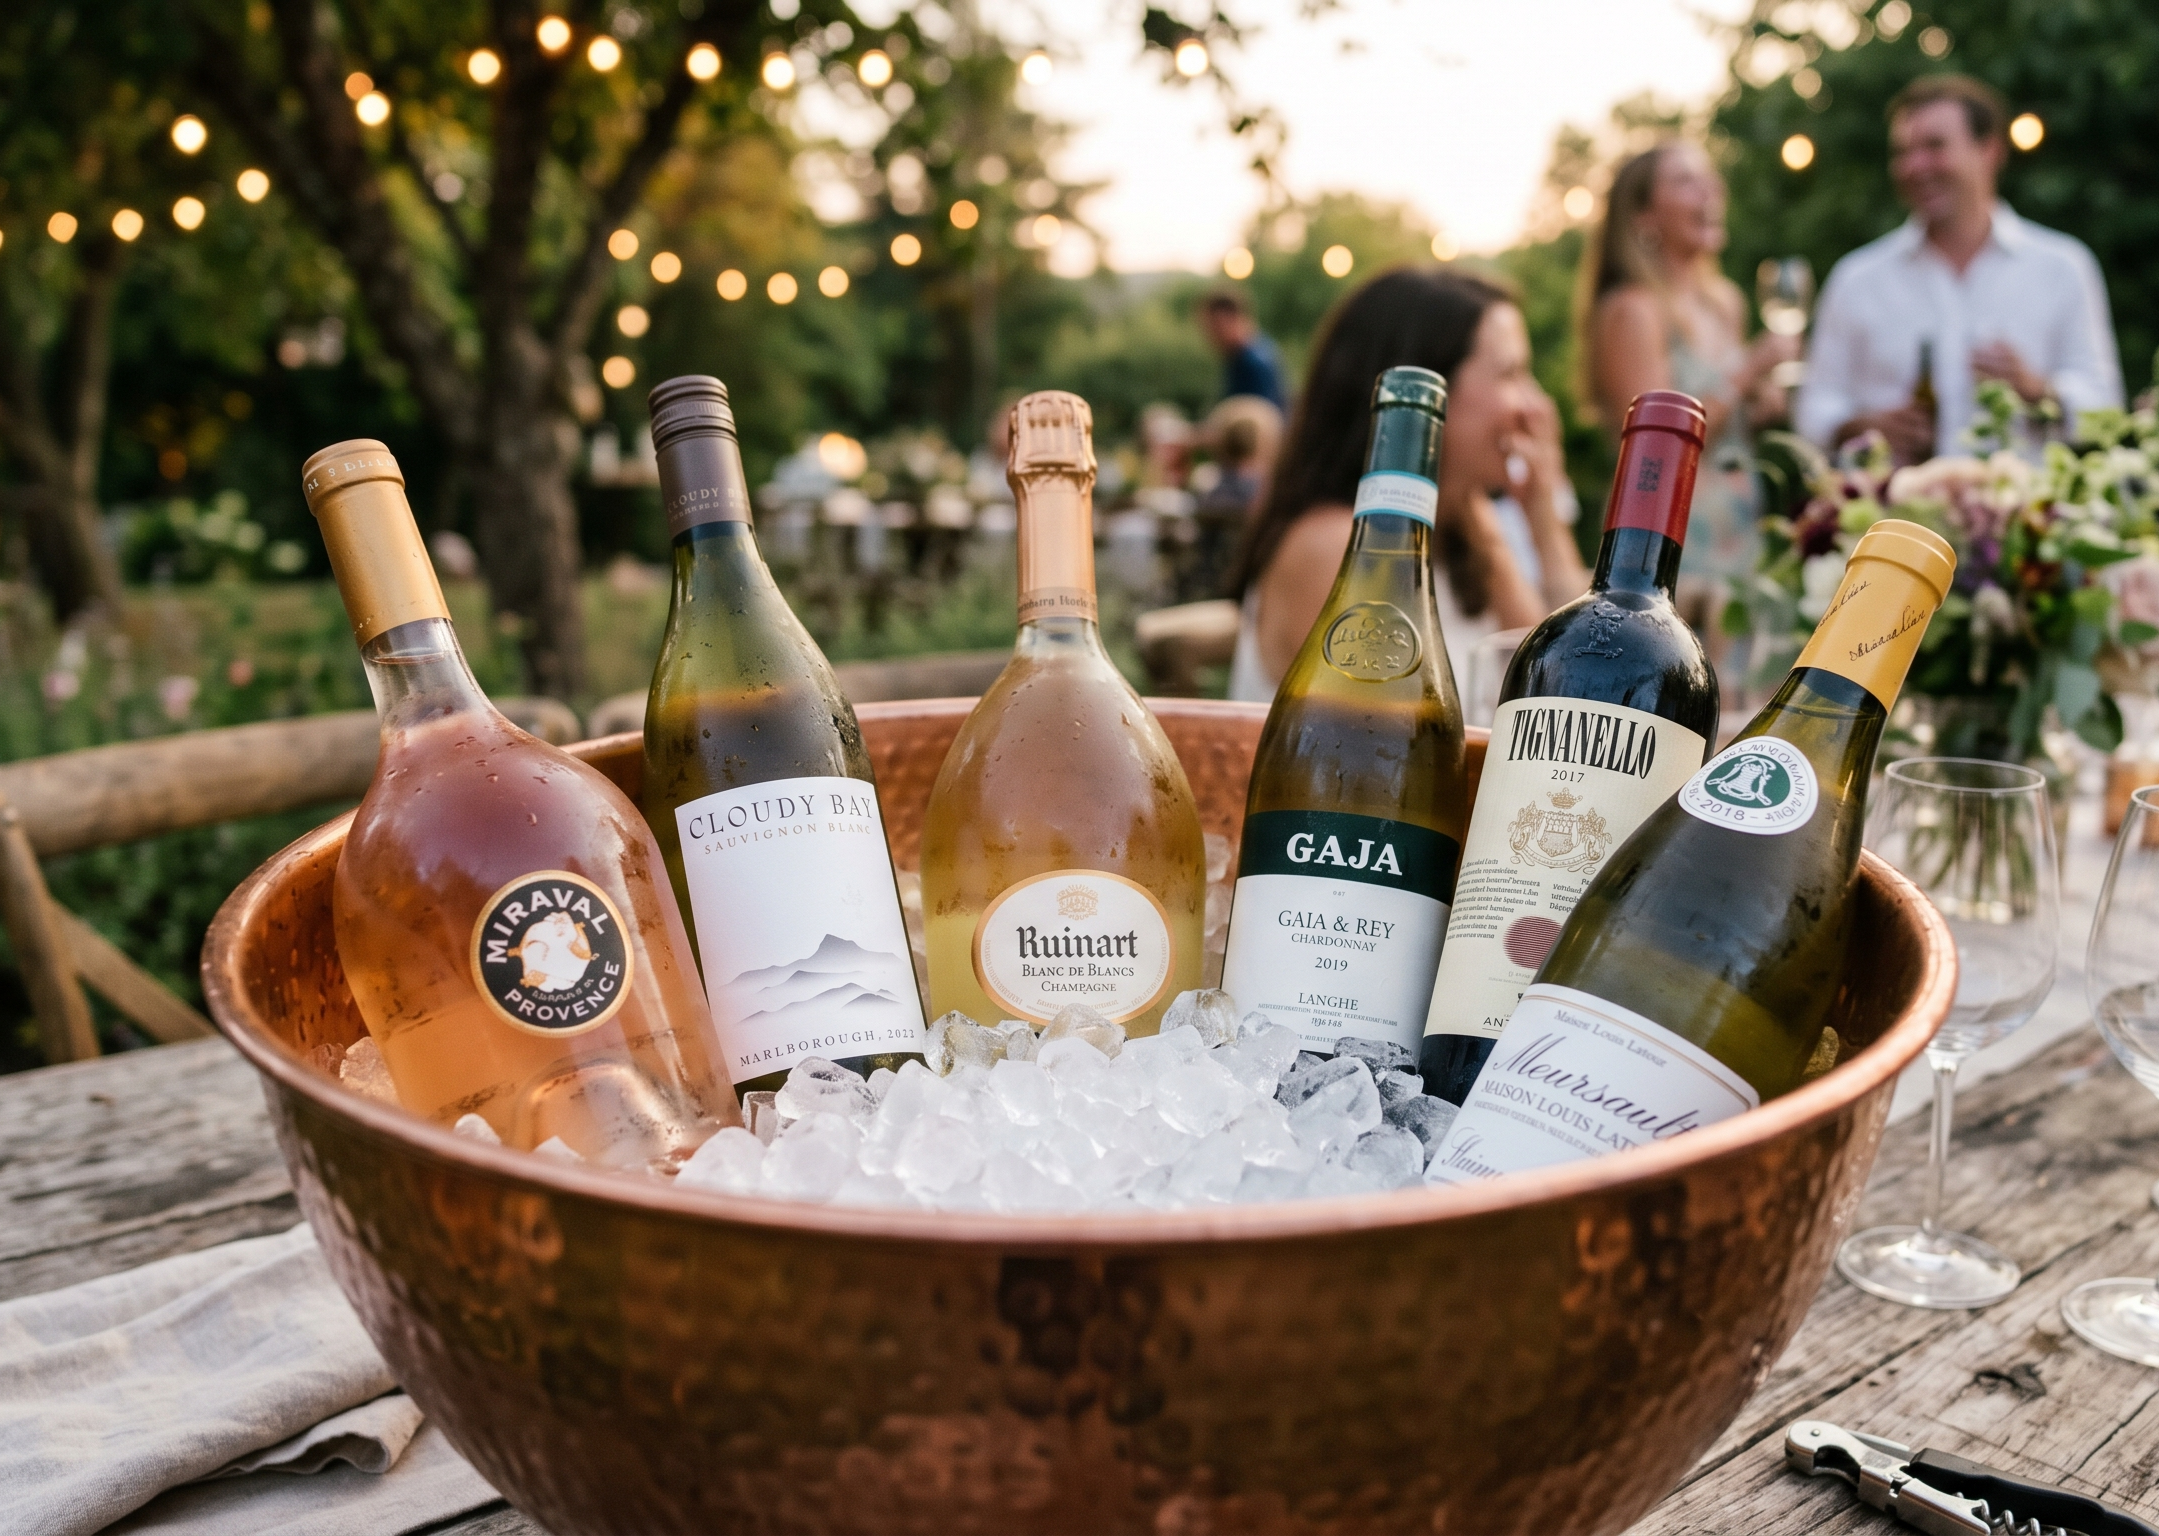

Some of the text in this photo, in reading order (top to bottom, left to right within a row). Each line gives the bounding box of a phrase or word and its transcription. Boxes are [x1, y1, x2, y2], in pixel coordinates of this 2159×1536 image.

[1507, 707, 1656, 780] TIGNANELLO
[1550, 769, 1585, 783] 2017
[689, 793, 873, 840] CLOUDY BAY
[1699, 798, 1746, 821] 2018
[704, 822, 872, 855] SAUVIGNON BLANC
[1286, 832, 1403, 876] GAJA
[485, 888, 609, 964] MIRAVAL
[1278, 909, 1396, 940] GAIA & REY
[1016, 925, 1139, 959] Ruinart
[1291, 932, 1377, 953] CHARDONNAY
[1314, 956, 1349, 972] 2019
[504, 960, 620, 1021] PROVENCE
[1298, 992, 1359, 1011] LANGHE
[1483, 1016, 1510, 1028] AN
[739, 1030, 882, 1067] MARLBOROUGH,
[1481, 1079, 1538, 1107] MAISON
[1537, 1097, 1594, 1133] LOUIS
[1594, 1123, 1638, 1153] LAT
